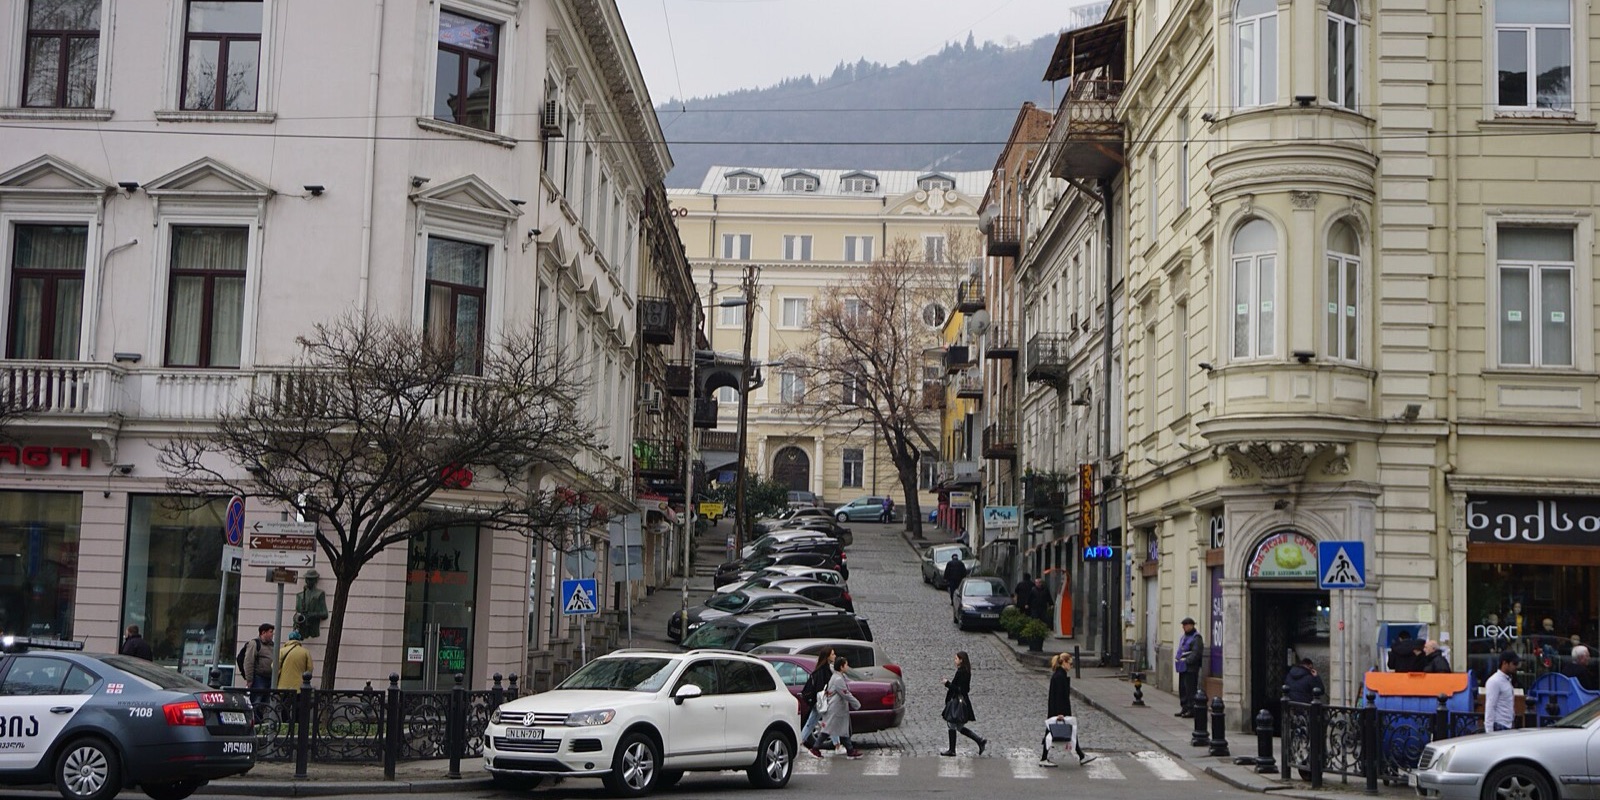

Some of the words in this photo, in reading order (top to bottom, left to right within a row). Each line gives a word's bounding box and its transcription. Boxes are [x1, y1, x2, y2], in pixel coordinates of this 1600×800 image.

[1474, 624, 1518, 638] next
[210, 693, 224, 703] 112
[129, 707, 153, 717] 7108
[510, 729, 542, 739] NLN-707
[223, 742, 253, 753] პოლიცია
